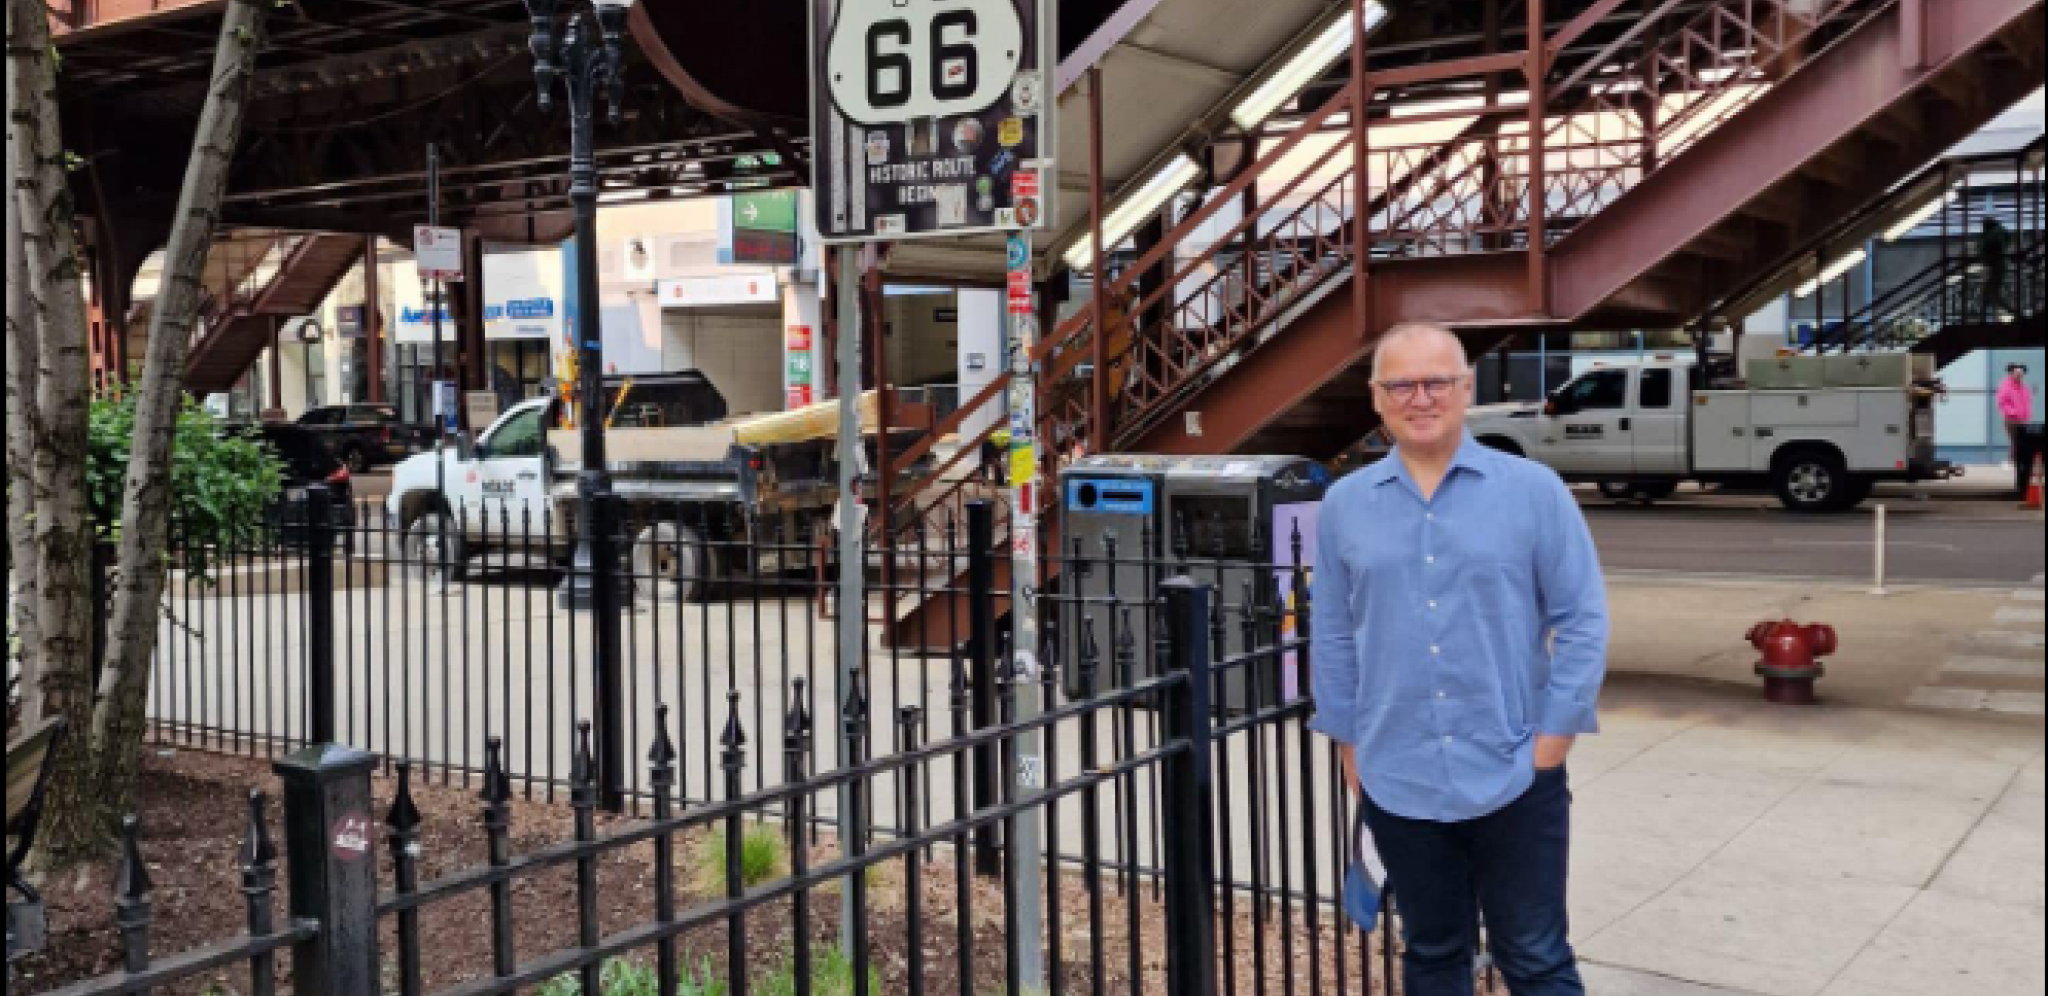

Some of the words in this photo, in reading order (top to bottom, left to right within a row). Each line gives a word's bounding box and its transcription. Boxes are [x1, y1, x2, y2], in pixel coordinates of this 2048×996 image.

[866, 9, 977, 108] 66
[870, 161, 930, 183] HISTORIC
[932, 156, 977, 178] ROUTE
